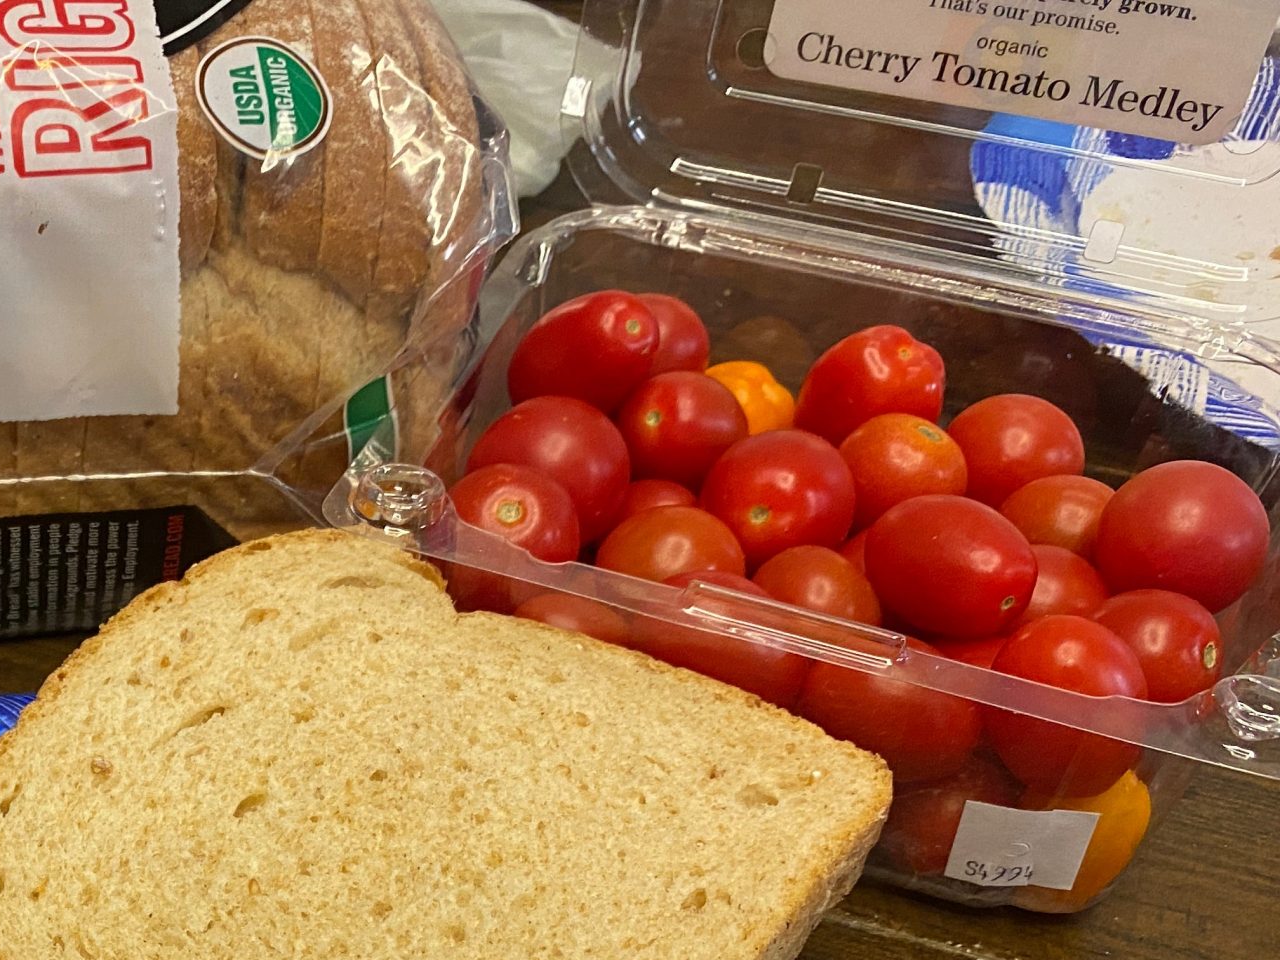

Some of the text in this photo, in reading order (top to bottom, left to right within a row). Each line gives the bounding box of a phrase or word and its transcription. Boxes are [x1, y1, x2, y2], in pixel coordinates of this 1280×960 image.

[993, 4, 1029, 21] our
[1030, 11, 1120, 35] promise.
[976, 35, 1048, 58] organic
[229, 64, 265, 125] USDA
[266, 55, 297, 135] ORGANIC
[796, 31, 1225, 132] Cherry Tomato Medley
[8, 526, 22, 570] witnessed
[47, 523, 62, 555] people
[64, 522, 81, 553] Pledge
[87, 522, 100, 547] more
[106, 520, 120, 550] power
[121, 519, 139, 580] Employment.
[27, 524, 43, 580] employment
[104, 551, 118, 567] the
[7, 572, 20, 588] has
[84, 549, 99, 589] motivate
[26, 581, 39, 608] stable
